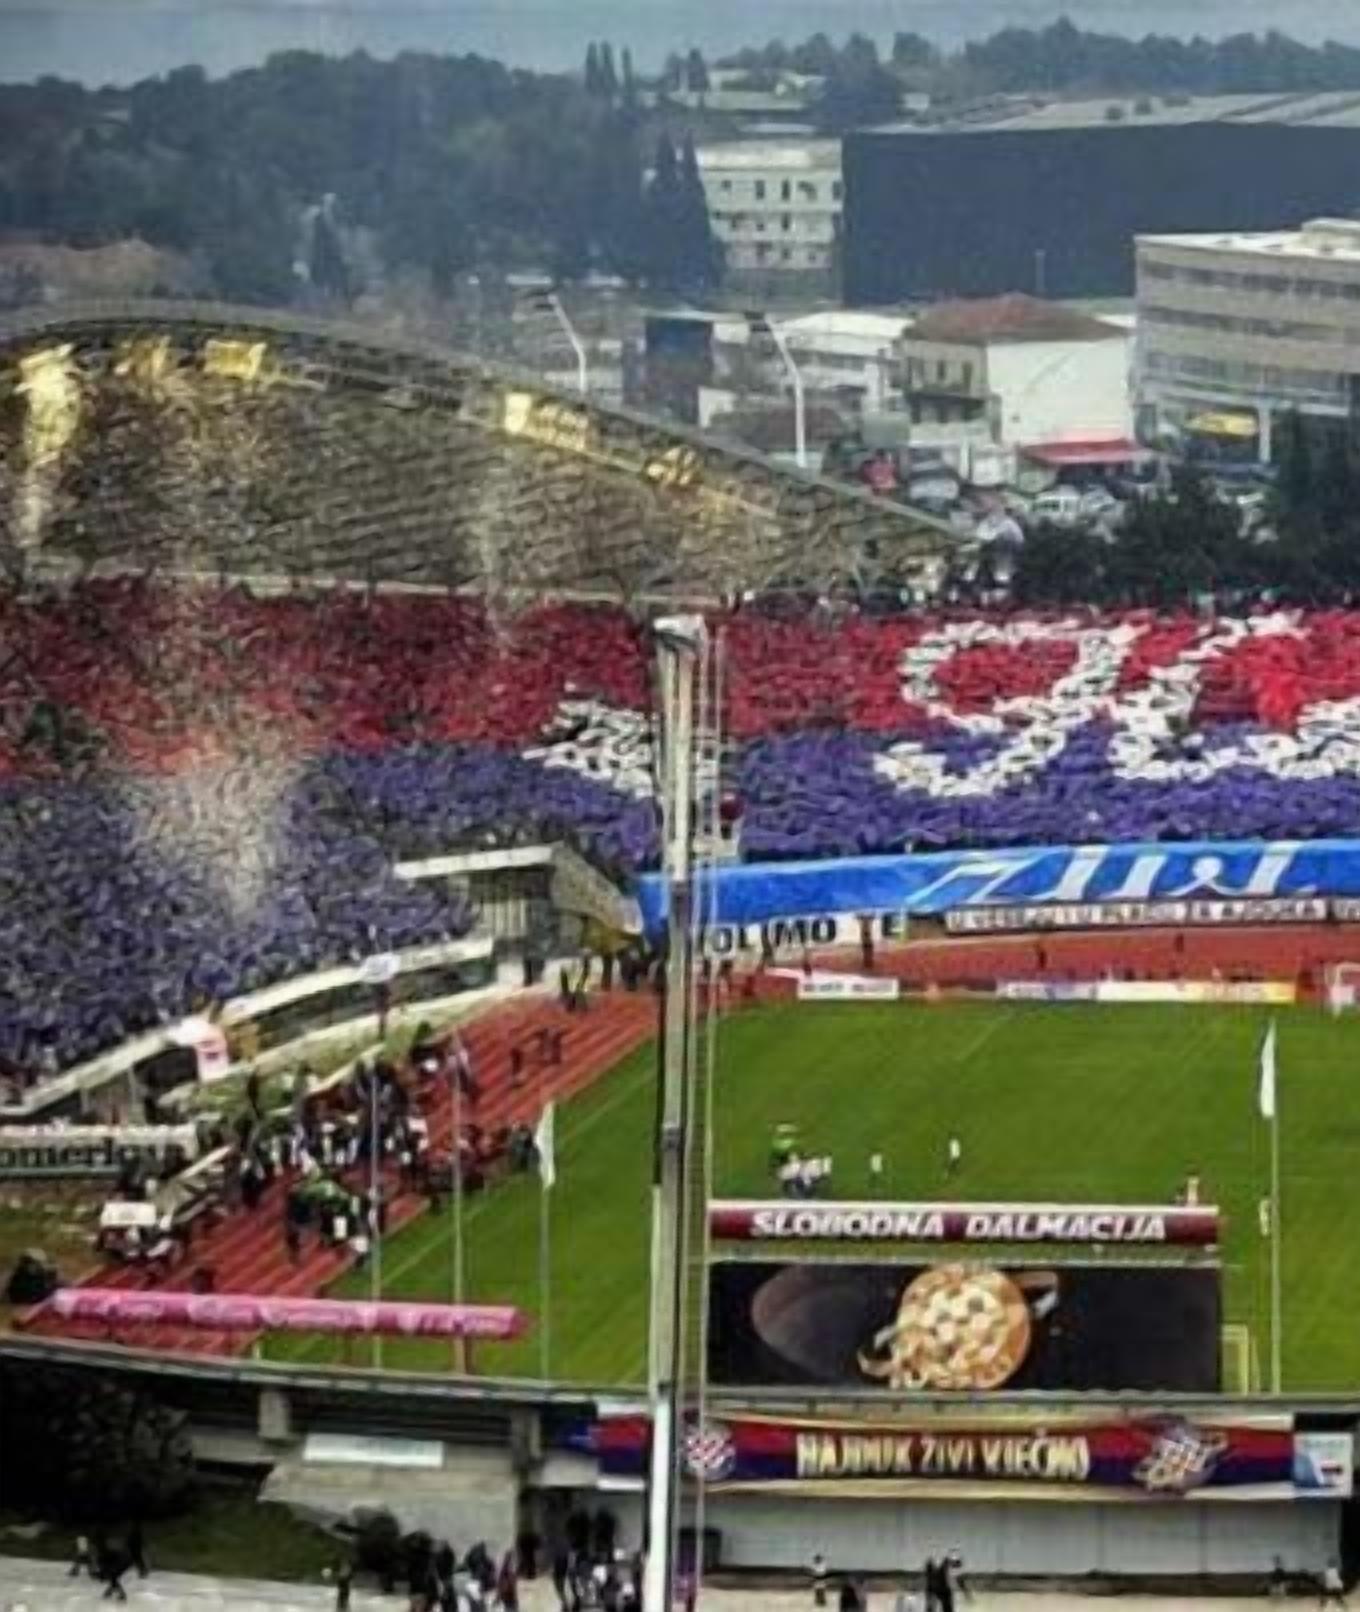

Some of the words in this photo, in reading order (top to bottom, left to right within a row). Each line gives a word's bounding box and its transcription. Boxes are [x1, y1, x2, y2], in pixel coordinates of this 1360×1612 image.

[749, 1210, 944, 1238] SLOBODNA
[966, 1212, 1167, 1241] DALMACIJA
[796, 1433, 913, 1477] HAJDUK
